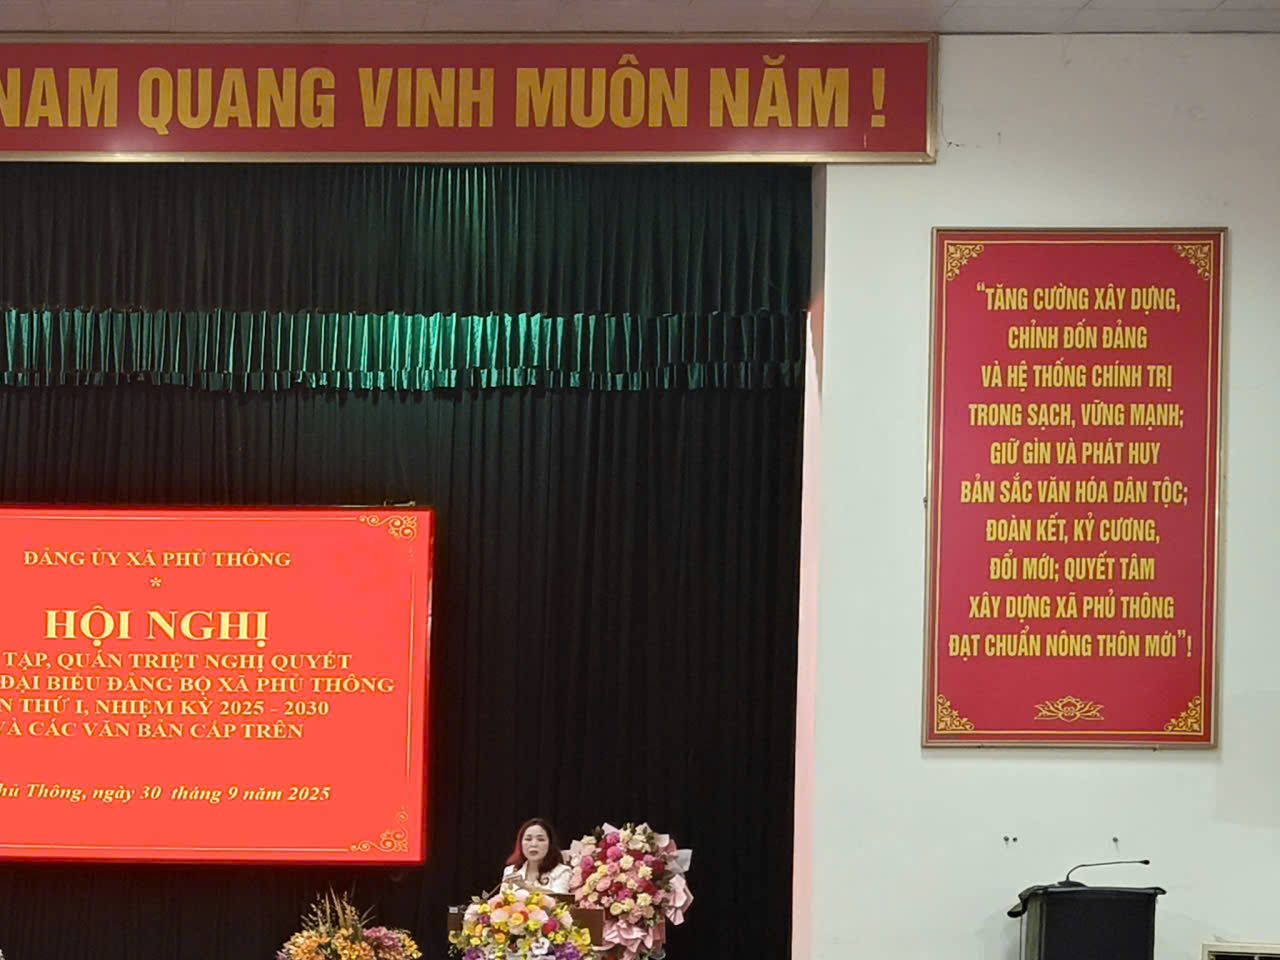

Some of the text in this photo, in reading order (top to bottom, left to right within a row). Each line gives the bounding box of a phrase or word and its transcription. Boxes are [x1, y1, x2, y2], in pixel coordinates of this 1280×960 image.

[137, 66, 336, 136] QUANG
[358, 66, 495, 128] VINH
[514, 53, 690, 129] MUÔN
[708, 54, 850, 128] NĂM
[870, 66, 887, 129] !
[976, 282, 1180, 315] “TĂNG CƯỜNG XÂY DỰNG,
[1008, 318, 1147, 349] CHỈNH ĐỐN ĐẢNG
[981, 357, 1172, 392] VÀ HỆ THỐNG CHÍNH TRỊ
[968, 399, 1184, 431] TRONG SẠCH, VỮNG MẠNH;
[990, 437, 1160, 465] GIỮ GÌN VÀ PHÁT HUY
[960, 472, 1188, 508] BẢN SẮC VĂN HÓA DÂN TỘC;
[986, 512, 1160, 544] ĐOÀN KẾT, KỶ CƯƠNG,
[212, 548, 291, 566] THÔNG
[989, 548, 1155, 582] ĐỔI MỚI; QUYẾT TÂM
[968, 588, 1174, 623] XÂY DỰNG XÃ PHỦ THÔNG
[45, 605, 268, 648] HỘI NGHỊ
[948, 634, 981, 661] ĐẠT
[985, 625, 1041, 657] CHUẨN
[1046, 629, 1092, 657] NÔNG
[1096, 630, 1140, 657] THÔN
[57, 649, 122, 670] QUÁN
[205, 654, 264, 673] NGHỊ
[0, 675, 40, 693] ĐẠI
[310, 673, 394, 692] THÔNG
[76, 699, 89, 715] I,
[181, 697, 213, 715] KỲ
[220, 701, 264, 715] 2025
[284, 701, 329, 715] 2030
[29, 718, 76, 736] CÁC
[241, 720, 303, 738] TRÊN
[27, 784, 86, 802] Thông,
[92, 785, 135, 803] ngày
[140, 786, 161, 799] 30
[171, 786, 222, 804] tháng
[228, 787, 238, 799] 9
[243, 787, 282, 800] năm
[287, 787, 331, 800] 2025
